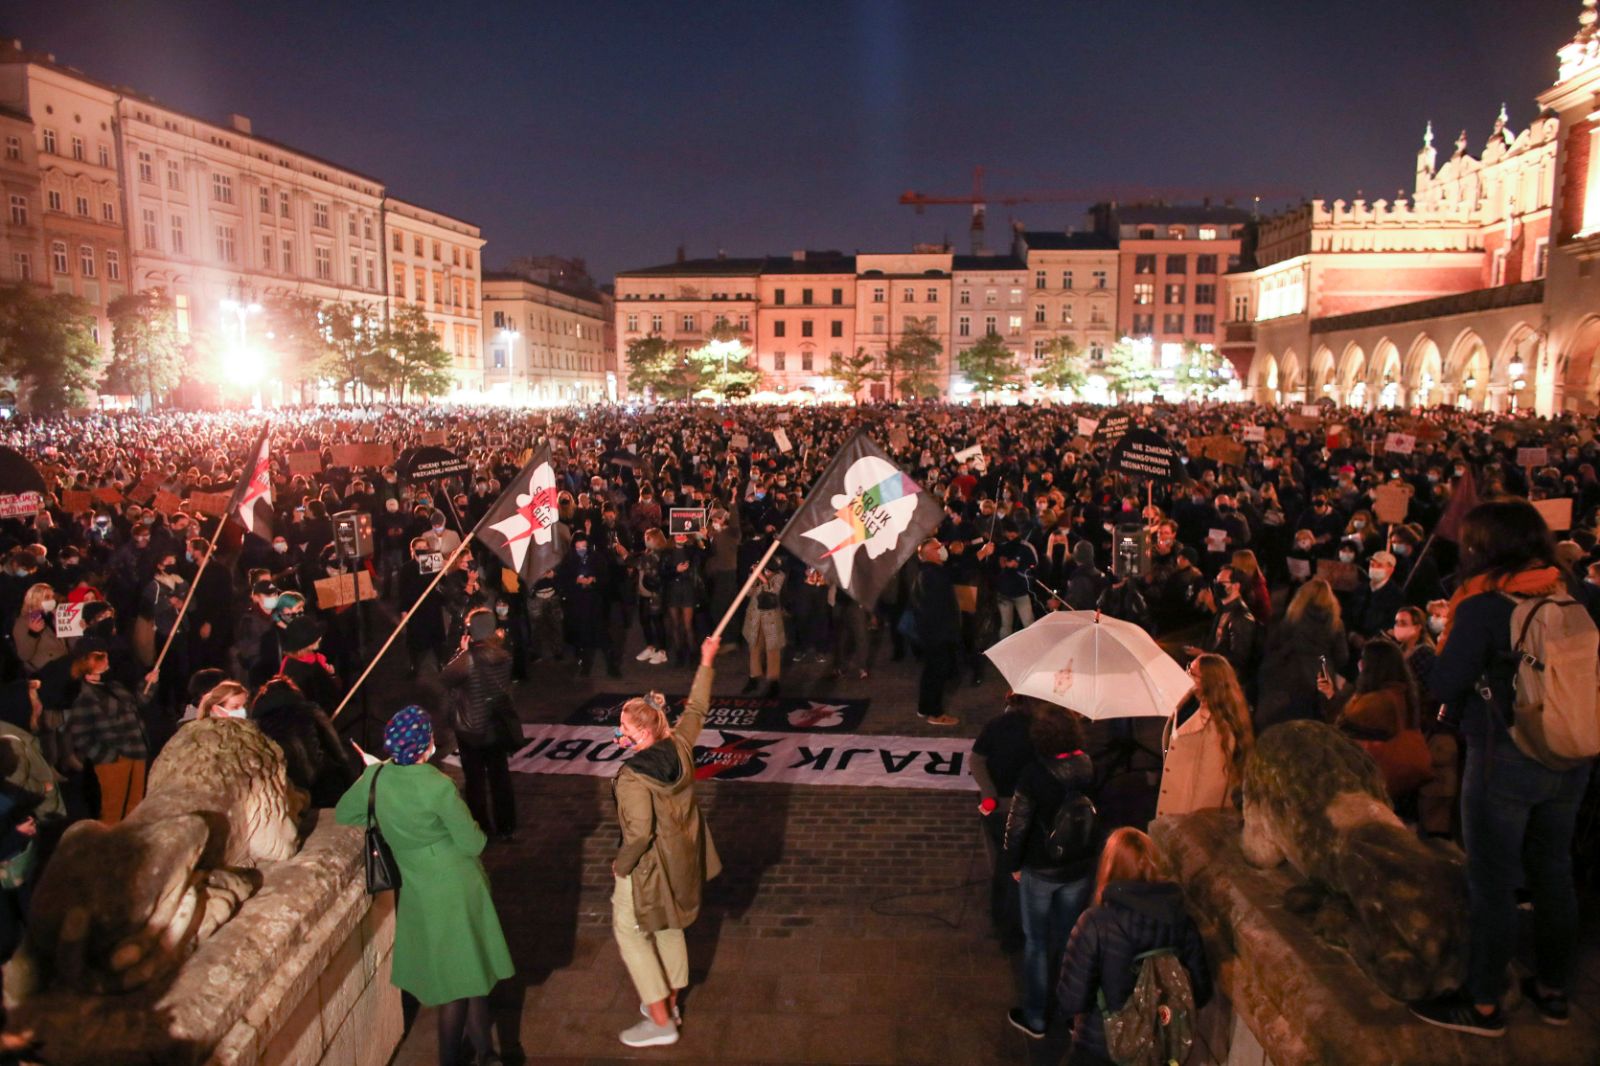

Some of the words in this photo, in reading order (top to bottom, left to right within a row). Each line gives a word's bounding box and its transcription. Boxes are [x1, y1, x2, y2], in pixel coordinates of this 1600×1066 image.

[1131, 442, 1144, 452] NIE
[1122, 450, 1170, 467] FINANSOWANIA
[856, 485, 892, 527] STRAJK
[847, 498, 881, 538] KOBIET
[706, 707, 760, 718] KOBI
[508, 737, 630, 762] OBI
[702, 750, 754, 760] KOBIET
[695, 756, 750, 767] STRAJK
[788, 746, 966, 777] RAJK
